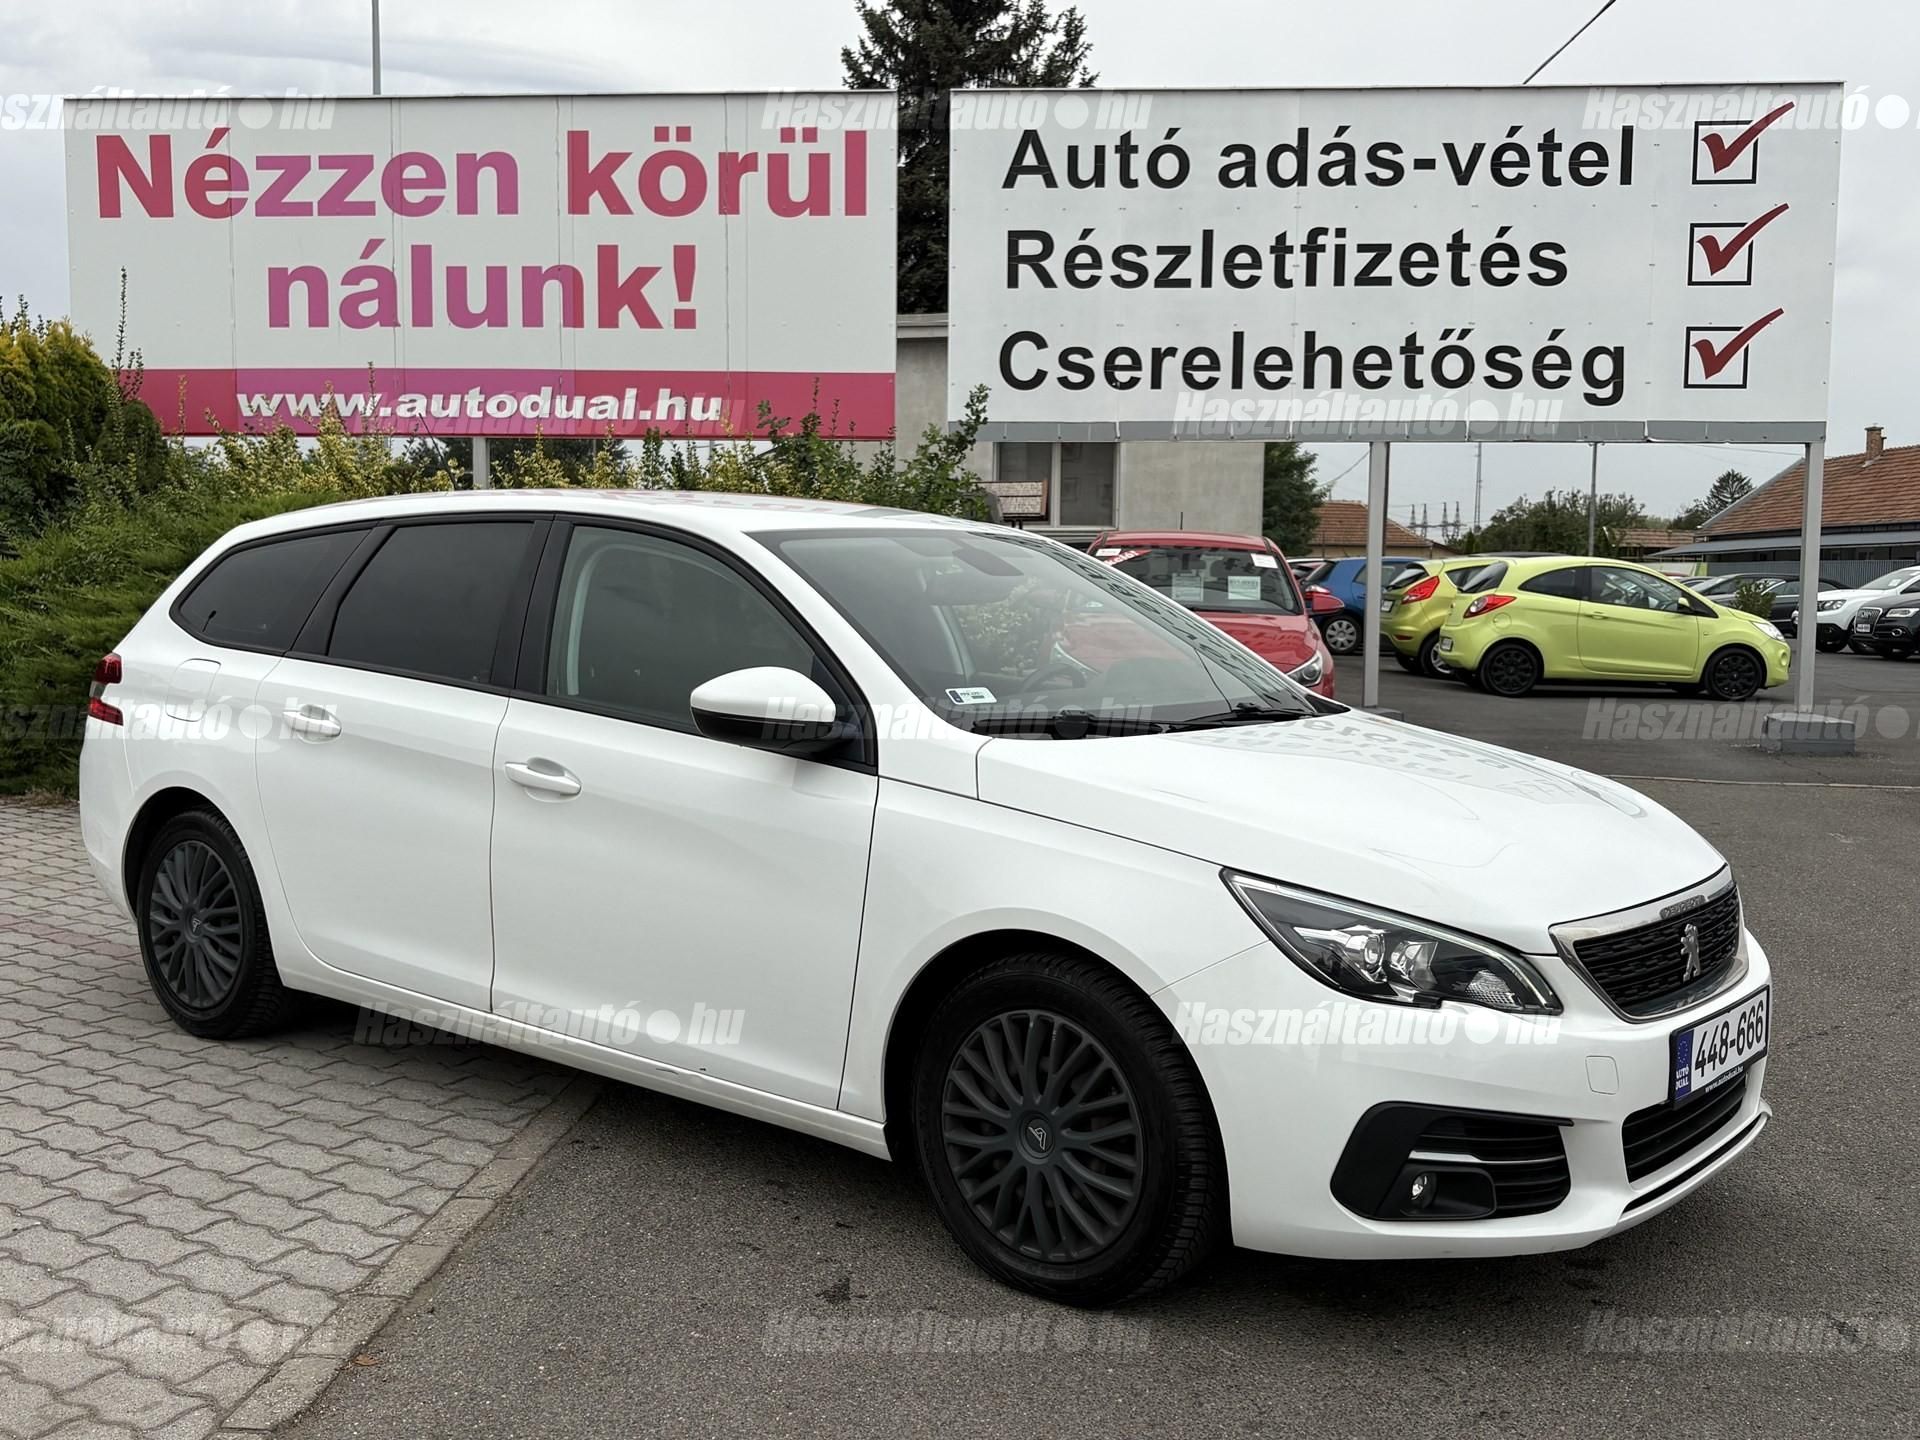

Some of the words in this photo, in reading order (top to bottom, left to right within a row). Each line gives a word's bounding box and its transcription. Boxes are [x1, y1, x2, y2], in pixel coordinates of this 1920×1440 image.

[96, 127, 519, 218] Nézzen
[567, 126, 868, 217] körül
[1001, 127, 1190, 189] Autó
[1217, 125, 1634, 188] adás-vétel
[268, 238, 697, 329] nálunk!
[1006, 226, 1568, 289] Részletfizetés
[236, 386, 723, 421] www.autodual.hu
[999, 328, 1625, 406] Cserelehetőség
[1695, 1000, 1763, 1077] 448-666
